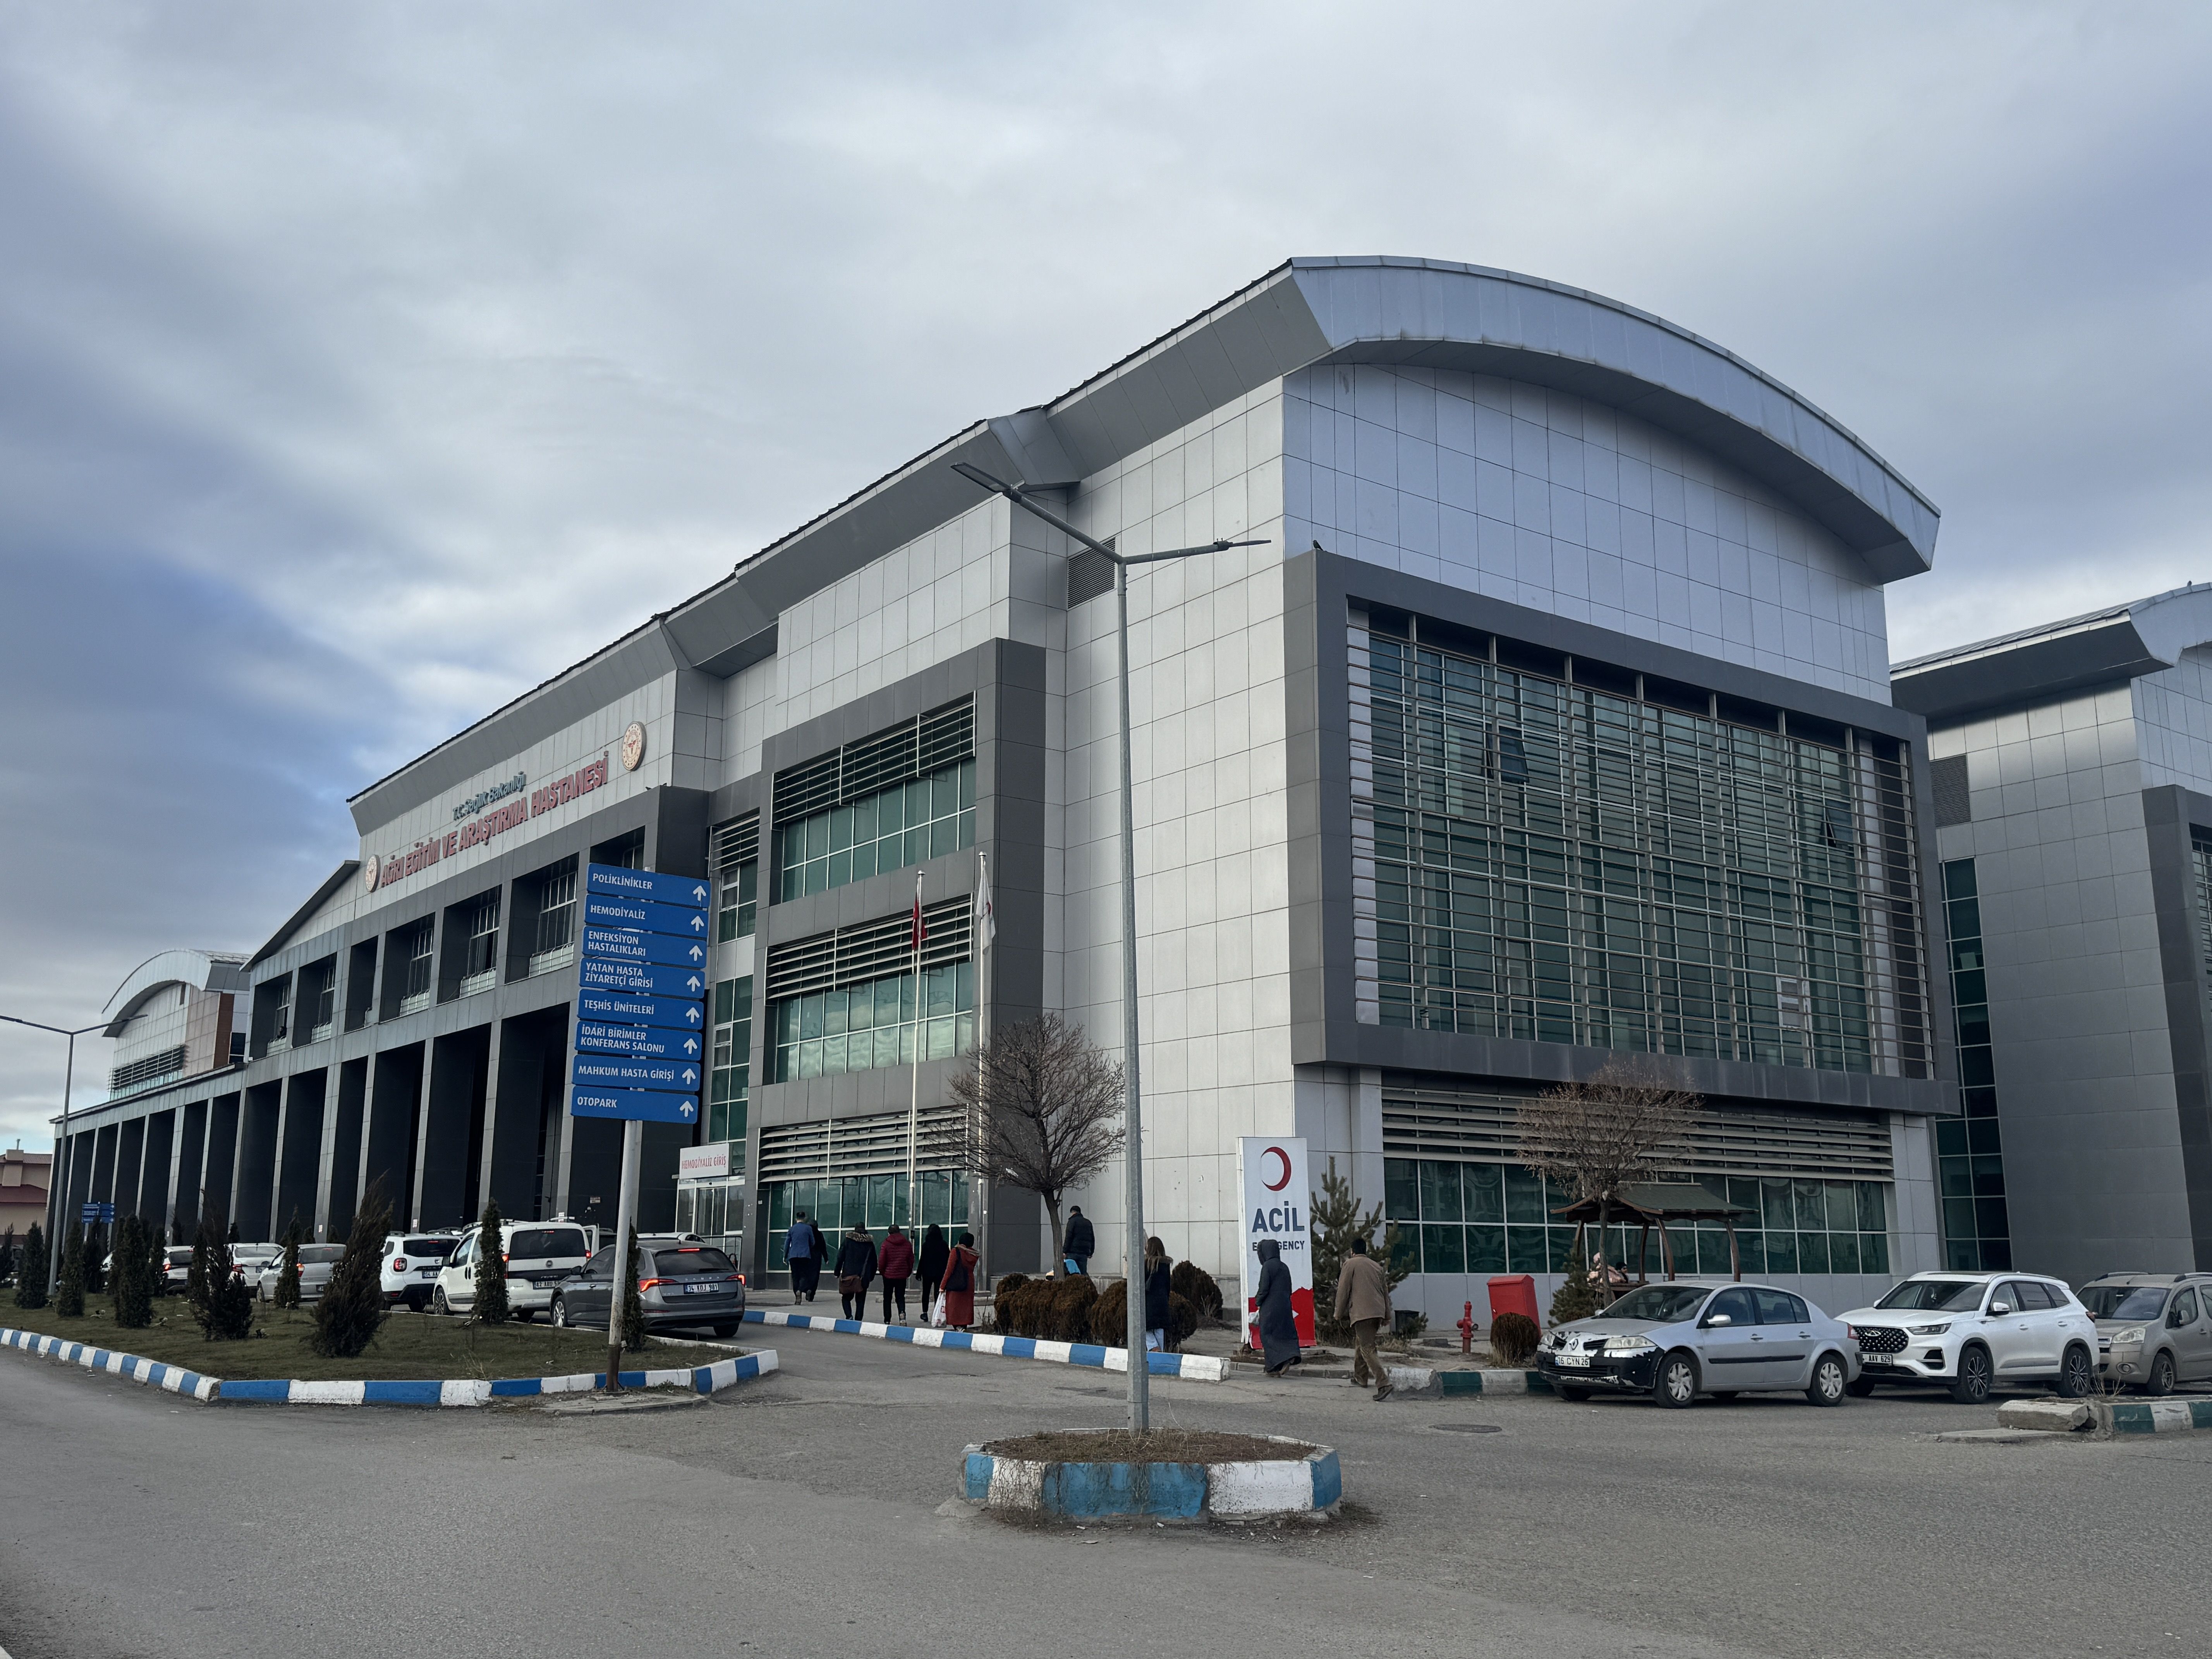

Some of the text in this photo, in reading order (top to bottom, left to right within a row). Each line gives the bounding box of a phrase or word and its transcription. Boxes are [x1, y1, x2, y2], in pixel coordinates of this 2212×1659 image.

[381, 750, 609, 888] AĞRI EĞİTİM VE ARAŞTIRMA HASTANESİ
[592, 873, 653, 890] POLİKLİNİKLER
[590, 905, 646, 920] HEMODİYALİZ
[588, 931, 639, 945] ENFEKSİYON
[588, 941, 646, 956] HASTALIKLARI
[586, 962, 643, 977] YATAN HASTA
[585, 971, 627, 987] ZİYARETÇİ
[584, 1000, 654, 1015] TEŞHİS ÜNİTELERİ
[582, 1024, 646, 1041] İDARİ BİRİMLER
[581, 1037, 665, 1053] KONFERANS SALONU
[578, 1065, 675, 1082] MAHKUM HASTA GİRİŞİ
[577, 1096, 617, 1108] OTOPARK
[1252, 1200, 1305, 1233] ACİL
[1252, 1240, 1305, 1251] EGENCY
